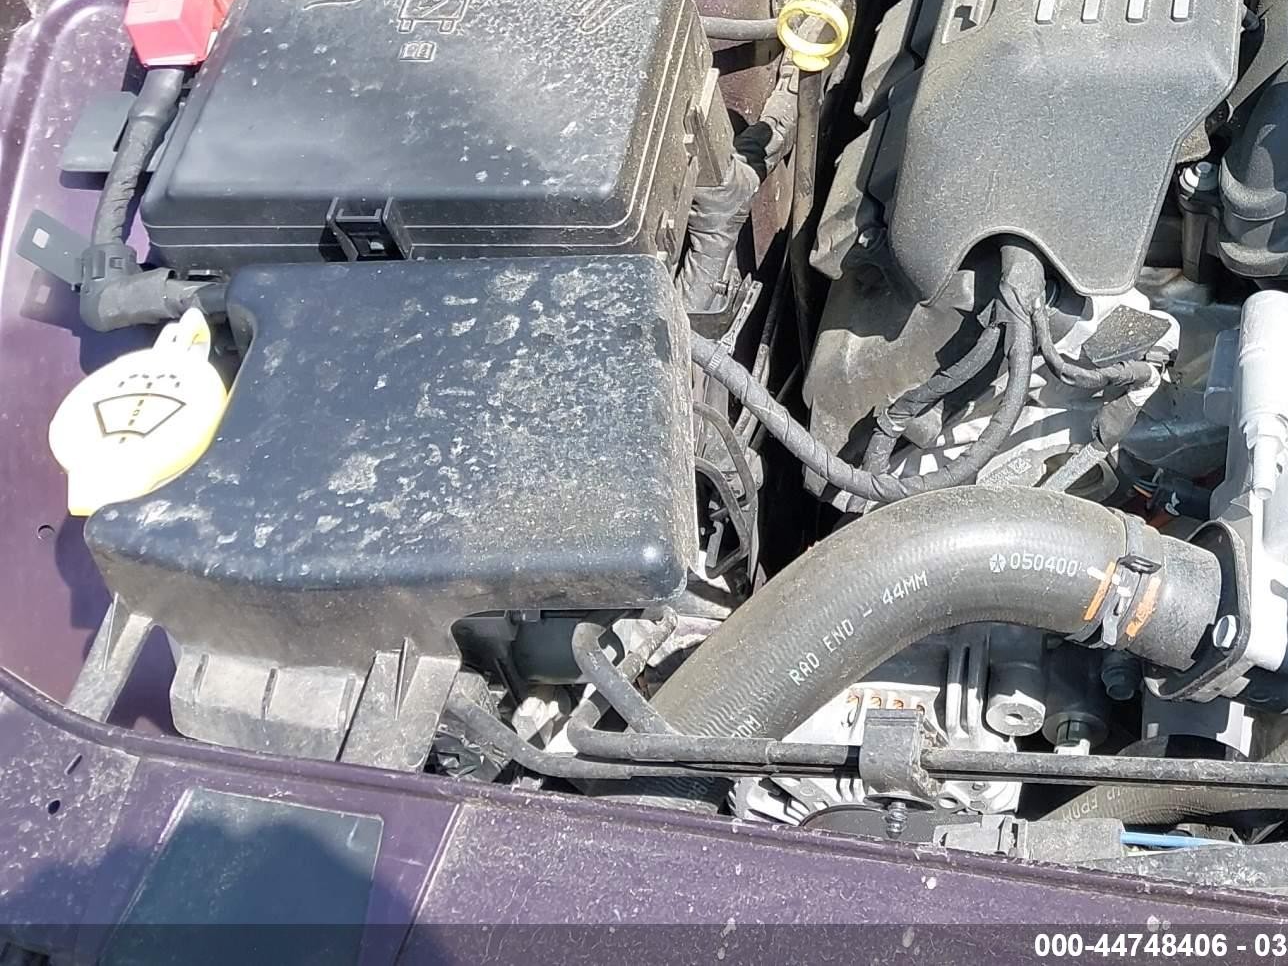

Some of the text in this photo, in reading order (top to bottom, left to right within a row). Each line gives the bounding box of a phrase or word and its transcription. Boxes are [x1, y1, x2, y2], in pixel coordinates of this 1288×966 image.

[1009, 552, 1085, 577] 050400
[789, 652, 820, 686] RAD
[822, 619, 854, 653] END
[882, 570, 928, 605] 44MM
